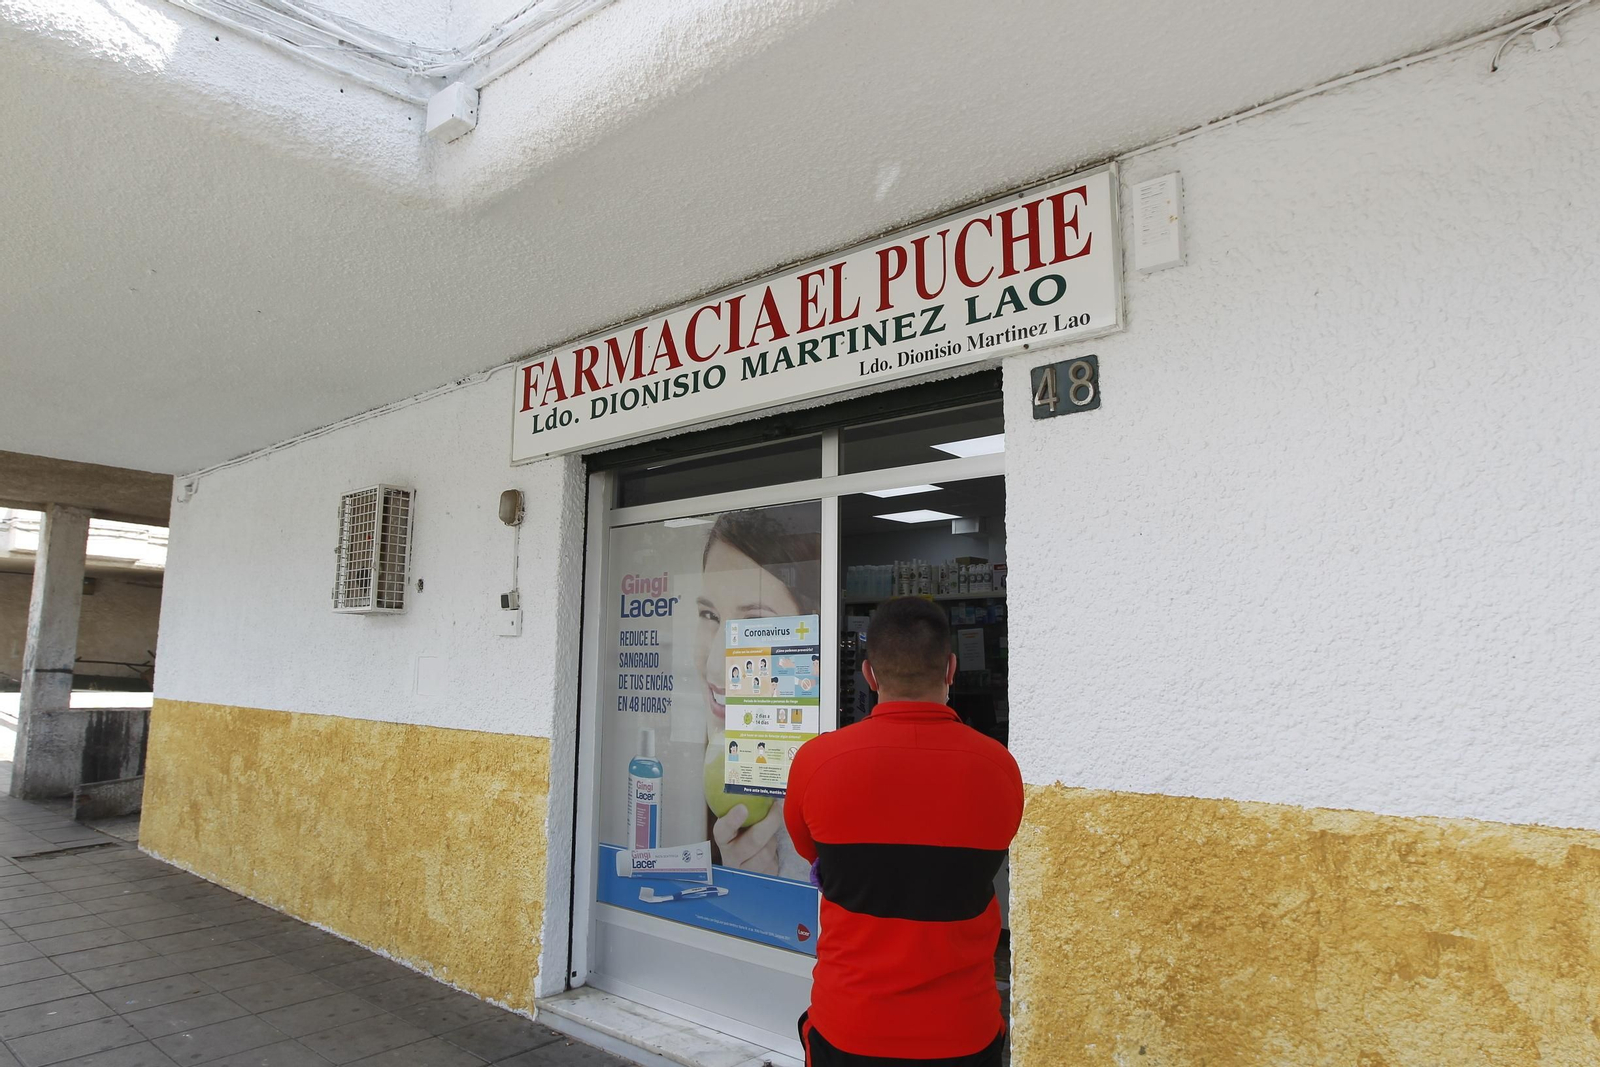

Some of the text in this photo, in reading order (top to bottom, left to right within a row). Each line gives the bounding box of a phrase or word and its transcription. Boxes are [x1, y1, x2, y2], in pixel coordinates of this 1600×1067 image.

[519, 285, 790, 413] FARMACIA
[796, 261, 861, 335] EL
[875, 185, 1092, 312] PUCHE
[859, 312, 1091, 376] Ldo. Dionisio Martinez Lao
[532, 273, 1067, 434] Ldo. DIONISIO MARTINEZ LAO
[1034, 360, 1096, 412] 48
[620, 571, 669, 598] Gingi
[620, 594, 679, 619] Lacer
[619, 629, 660, 647] REDUCE EL
[744, 626, 791, 638] Coronavirus
[618, 652, 660, 669] SANGRADO
[618, 671, 674, 692] DE TUS ENCÍAS
[617, 695, 628, 712] EN
[628, 695, 640, 713] 48
[635, 789, 655, 801] Lacer
[636, 780, 653, 792] Gingi
[631, 850, 651, 861] Gingi
[632, 859, 656, 869] Lacer
